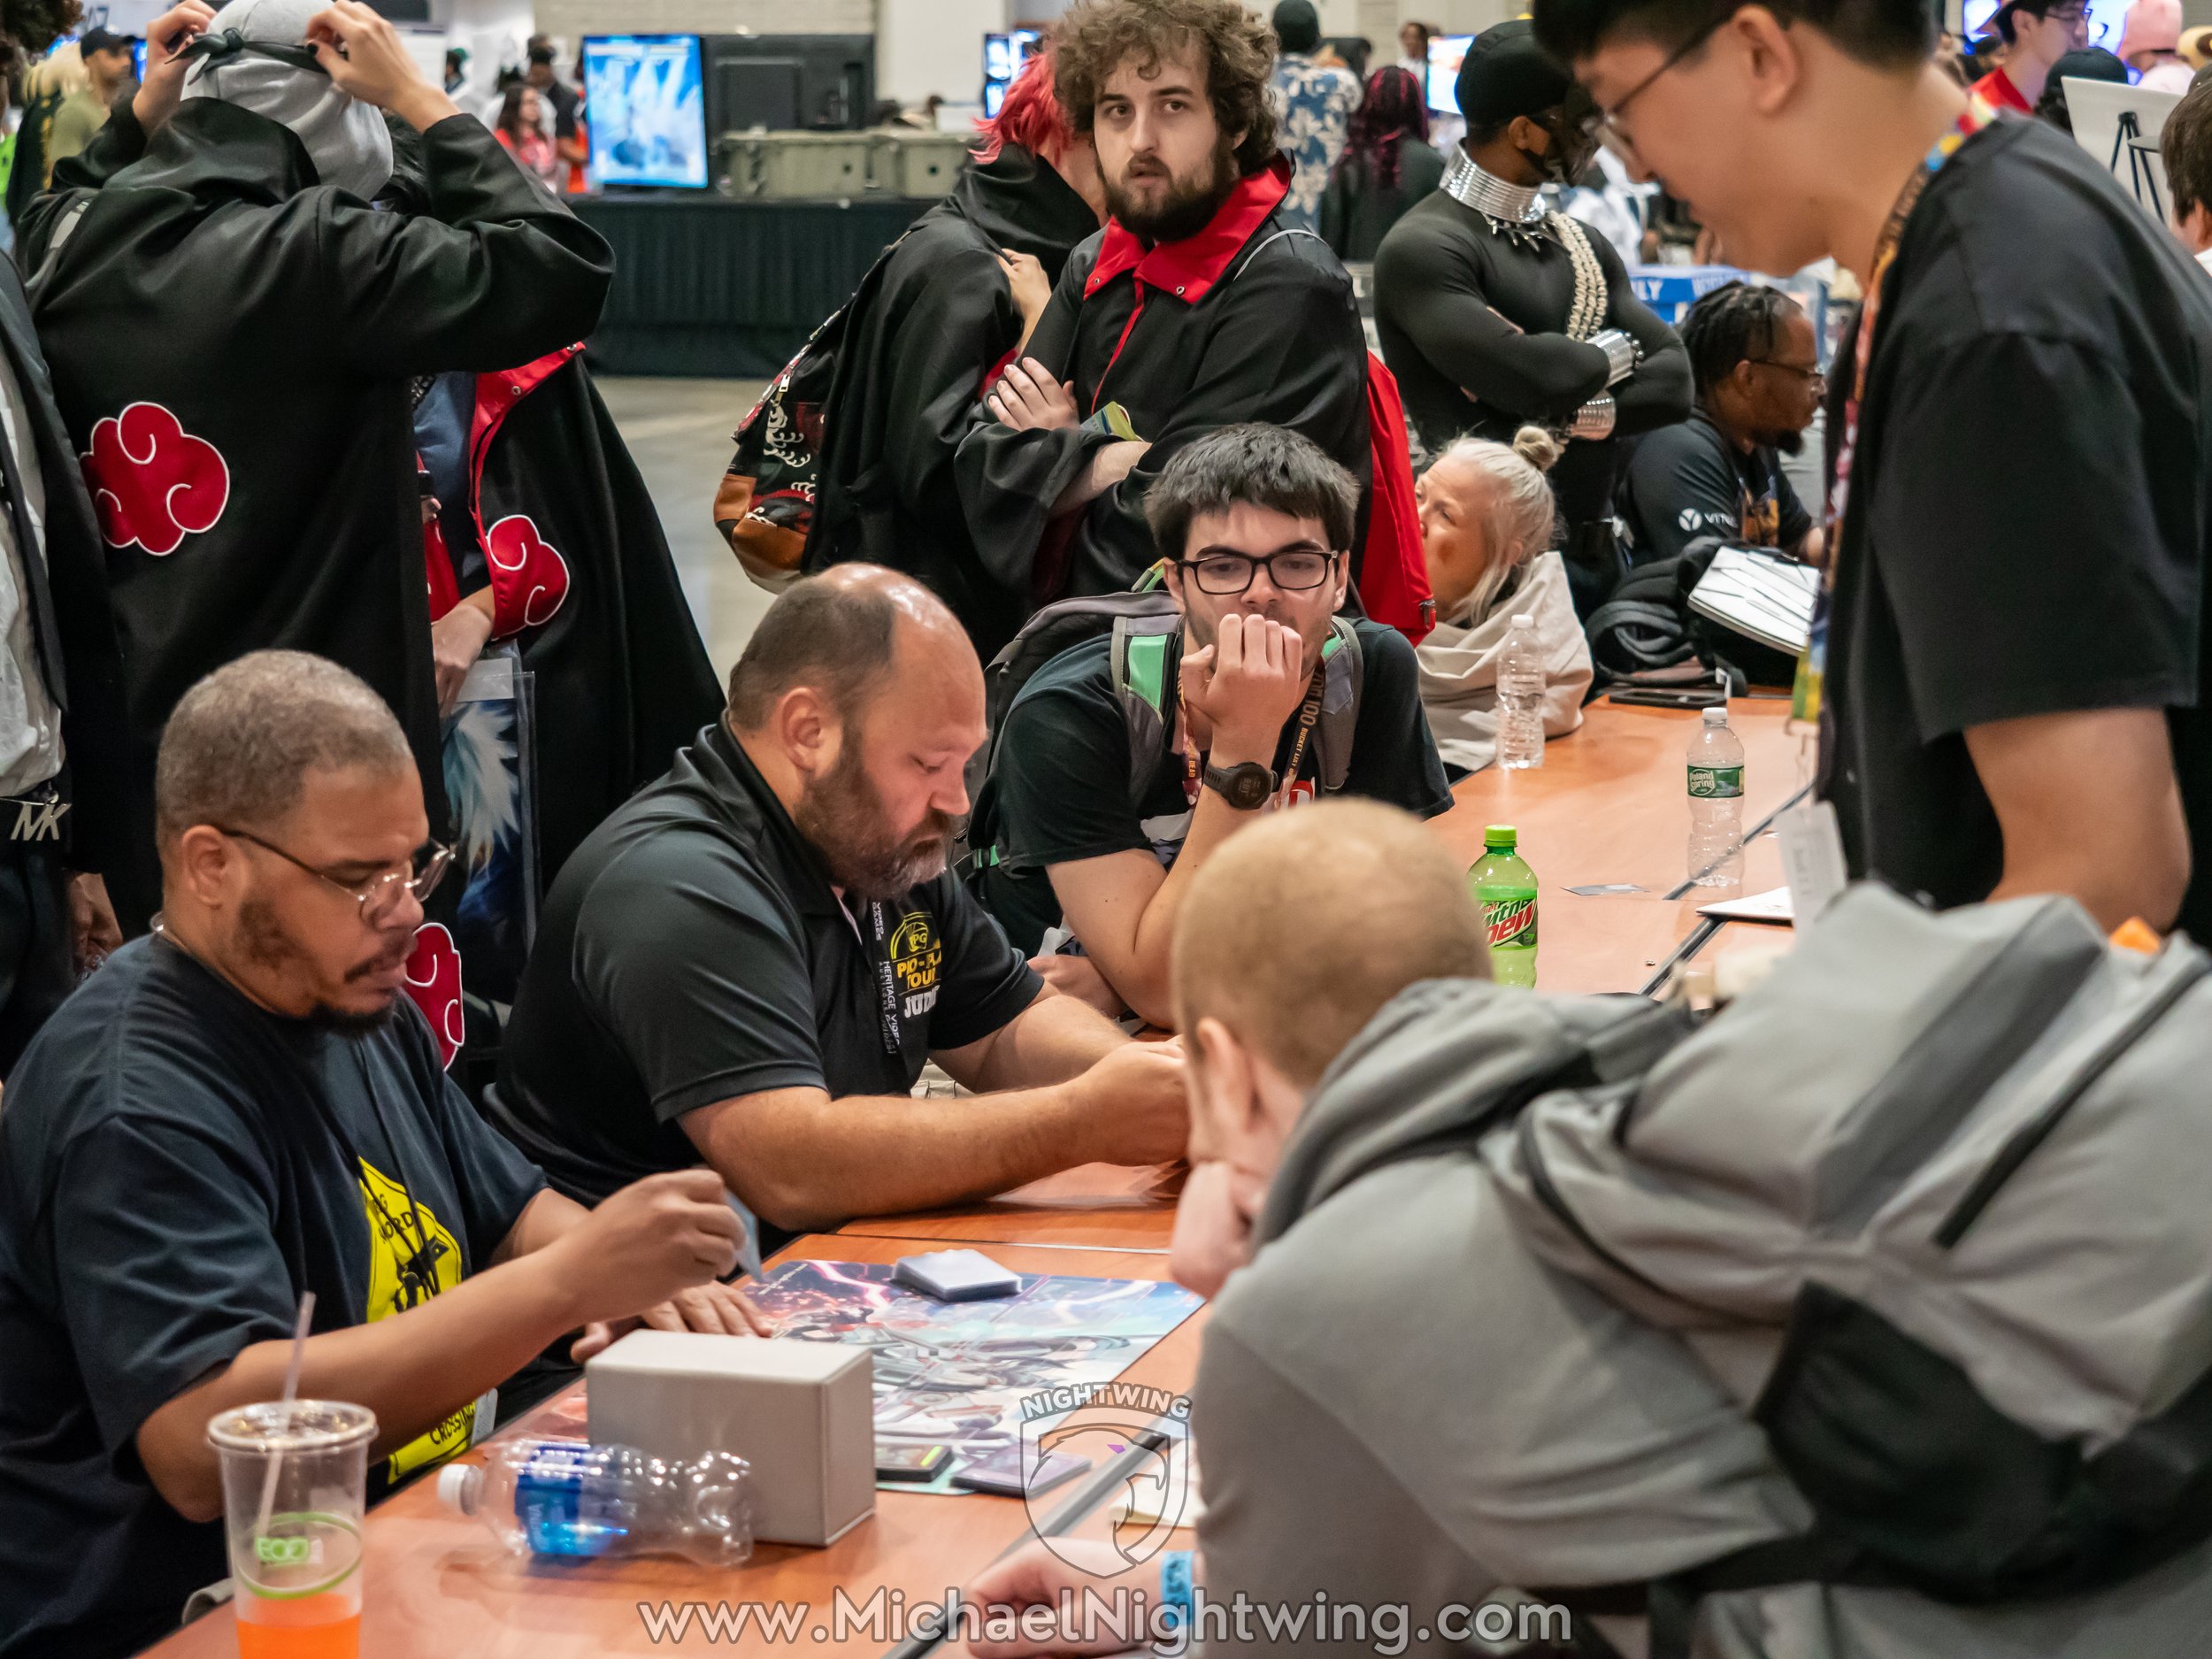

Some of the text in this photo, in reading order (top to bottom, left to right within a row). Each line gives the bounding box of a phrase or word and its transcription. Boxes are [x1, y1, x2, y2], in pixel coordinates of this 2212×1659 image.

[1294, 726, 1309, 751] BUCKET
[1689, 770, 1714, 780] Poland
[10, 803, 73, 841] MK
[872, 902, 882, 941] GAMES
[876, 902, 885, 935] VIDEO
[883, 961, 896, 1010] HERITAGE
